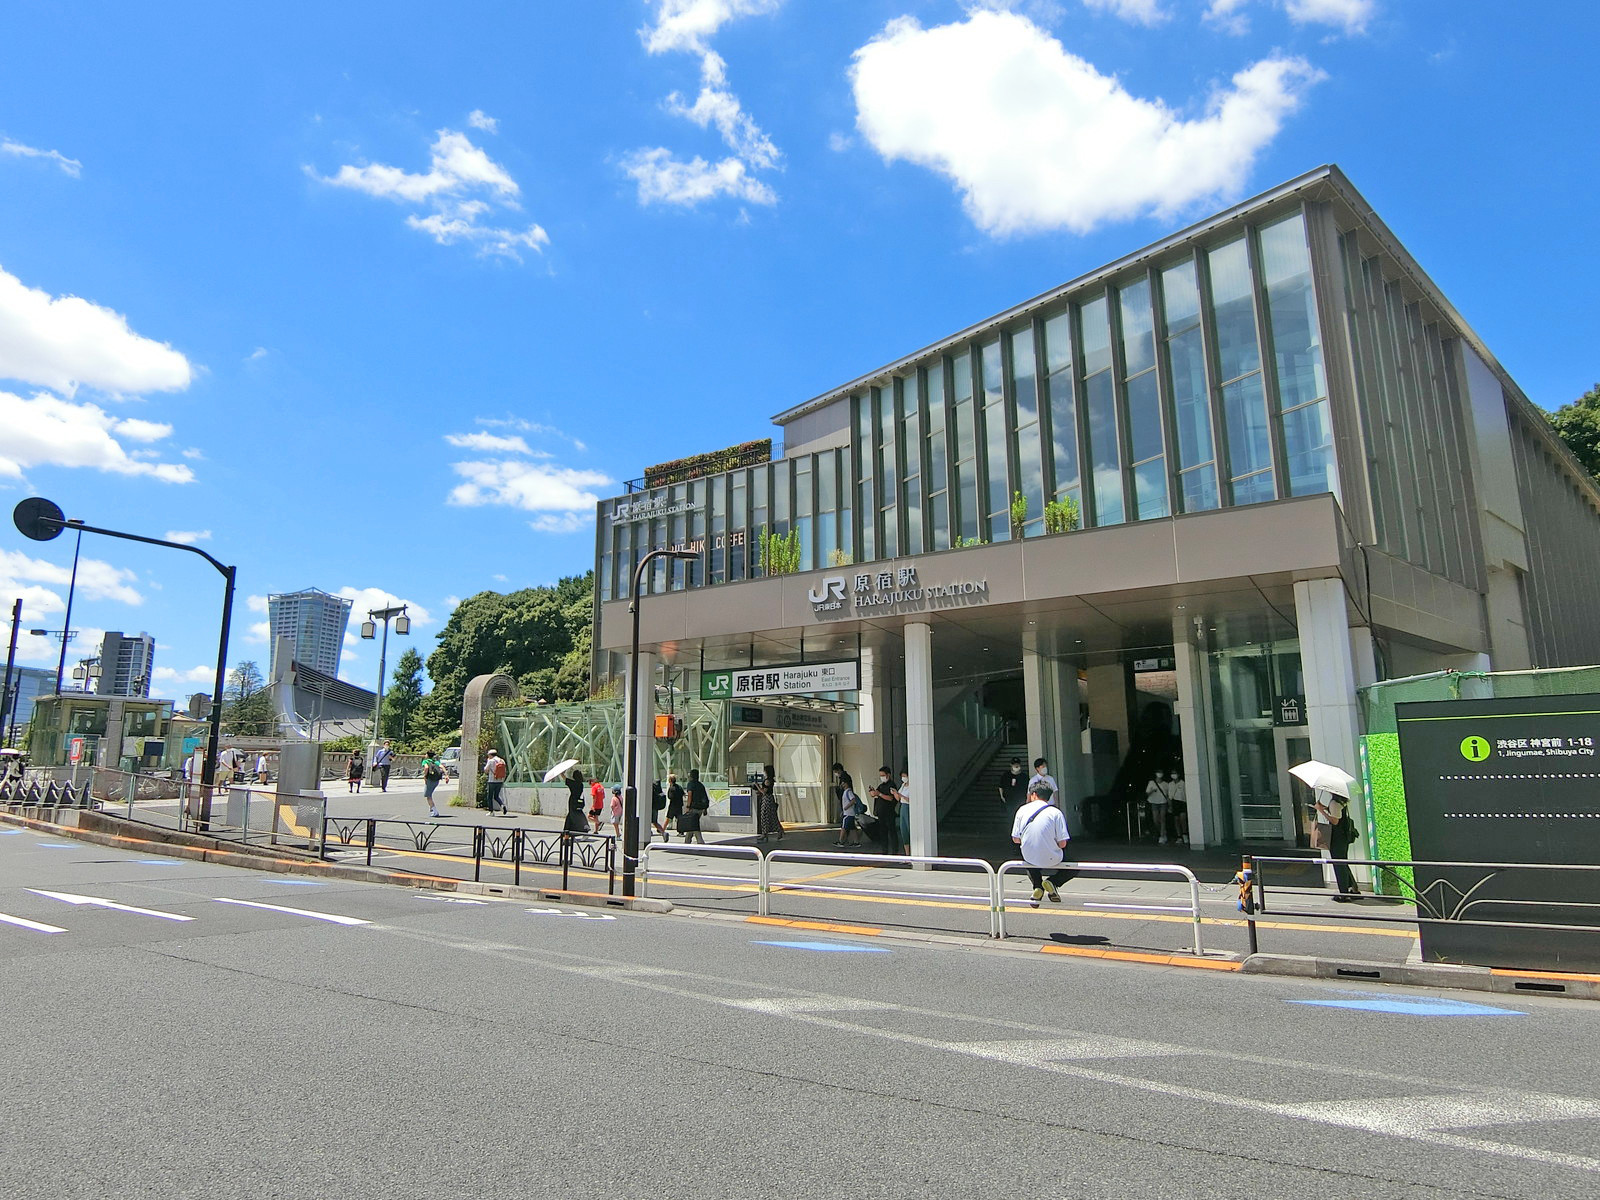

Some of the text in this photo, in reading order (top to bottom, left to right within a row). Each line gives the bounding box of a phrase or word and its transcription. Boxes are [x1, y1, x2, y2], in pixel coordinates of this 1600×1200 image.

[609, 503, 630, 521] JR
[632, 501, 696, 521] HARAJUKU STATION
[853, 566, 917, 593] 原宿駅
[808, 576, 846, 604] JR
[854, 581, 987, 608] HARAJUKU STATION
[783, 669, 818, 682] Harajuku
[821, 667, 836, 676] 東口
[708, 675, 729, 691] JR
[736, 673, 780, 692] 原宿駅
[783, 681, 812, 690] Station
[1496, 737, 1593, 749] 渋谷区 神宮前 1-18
[1506, 749, 1545, 758] Jingumae,
[1546, 748, 1577, 756] Shibuya
[1578, 747, 1595, 756] City
